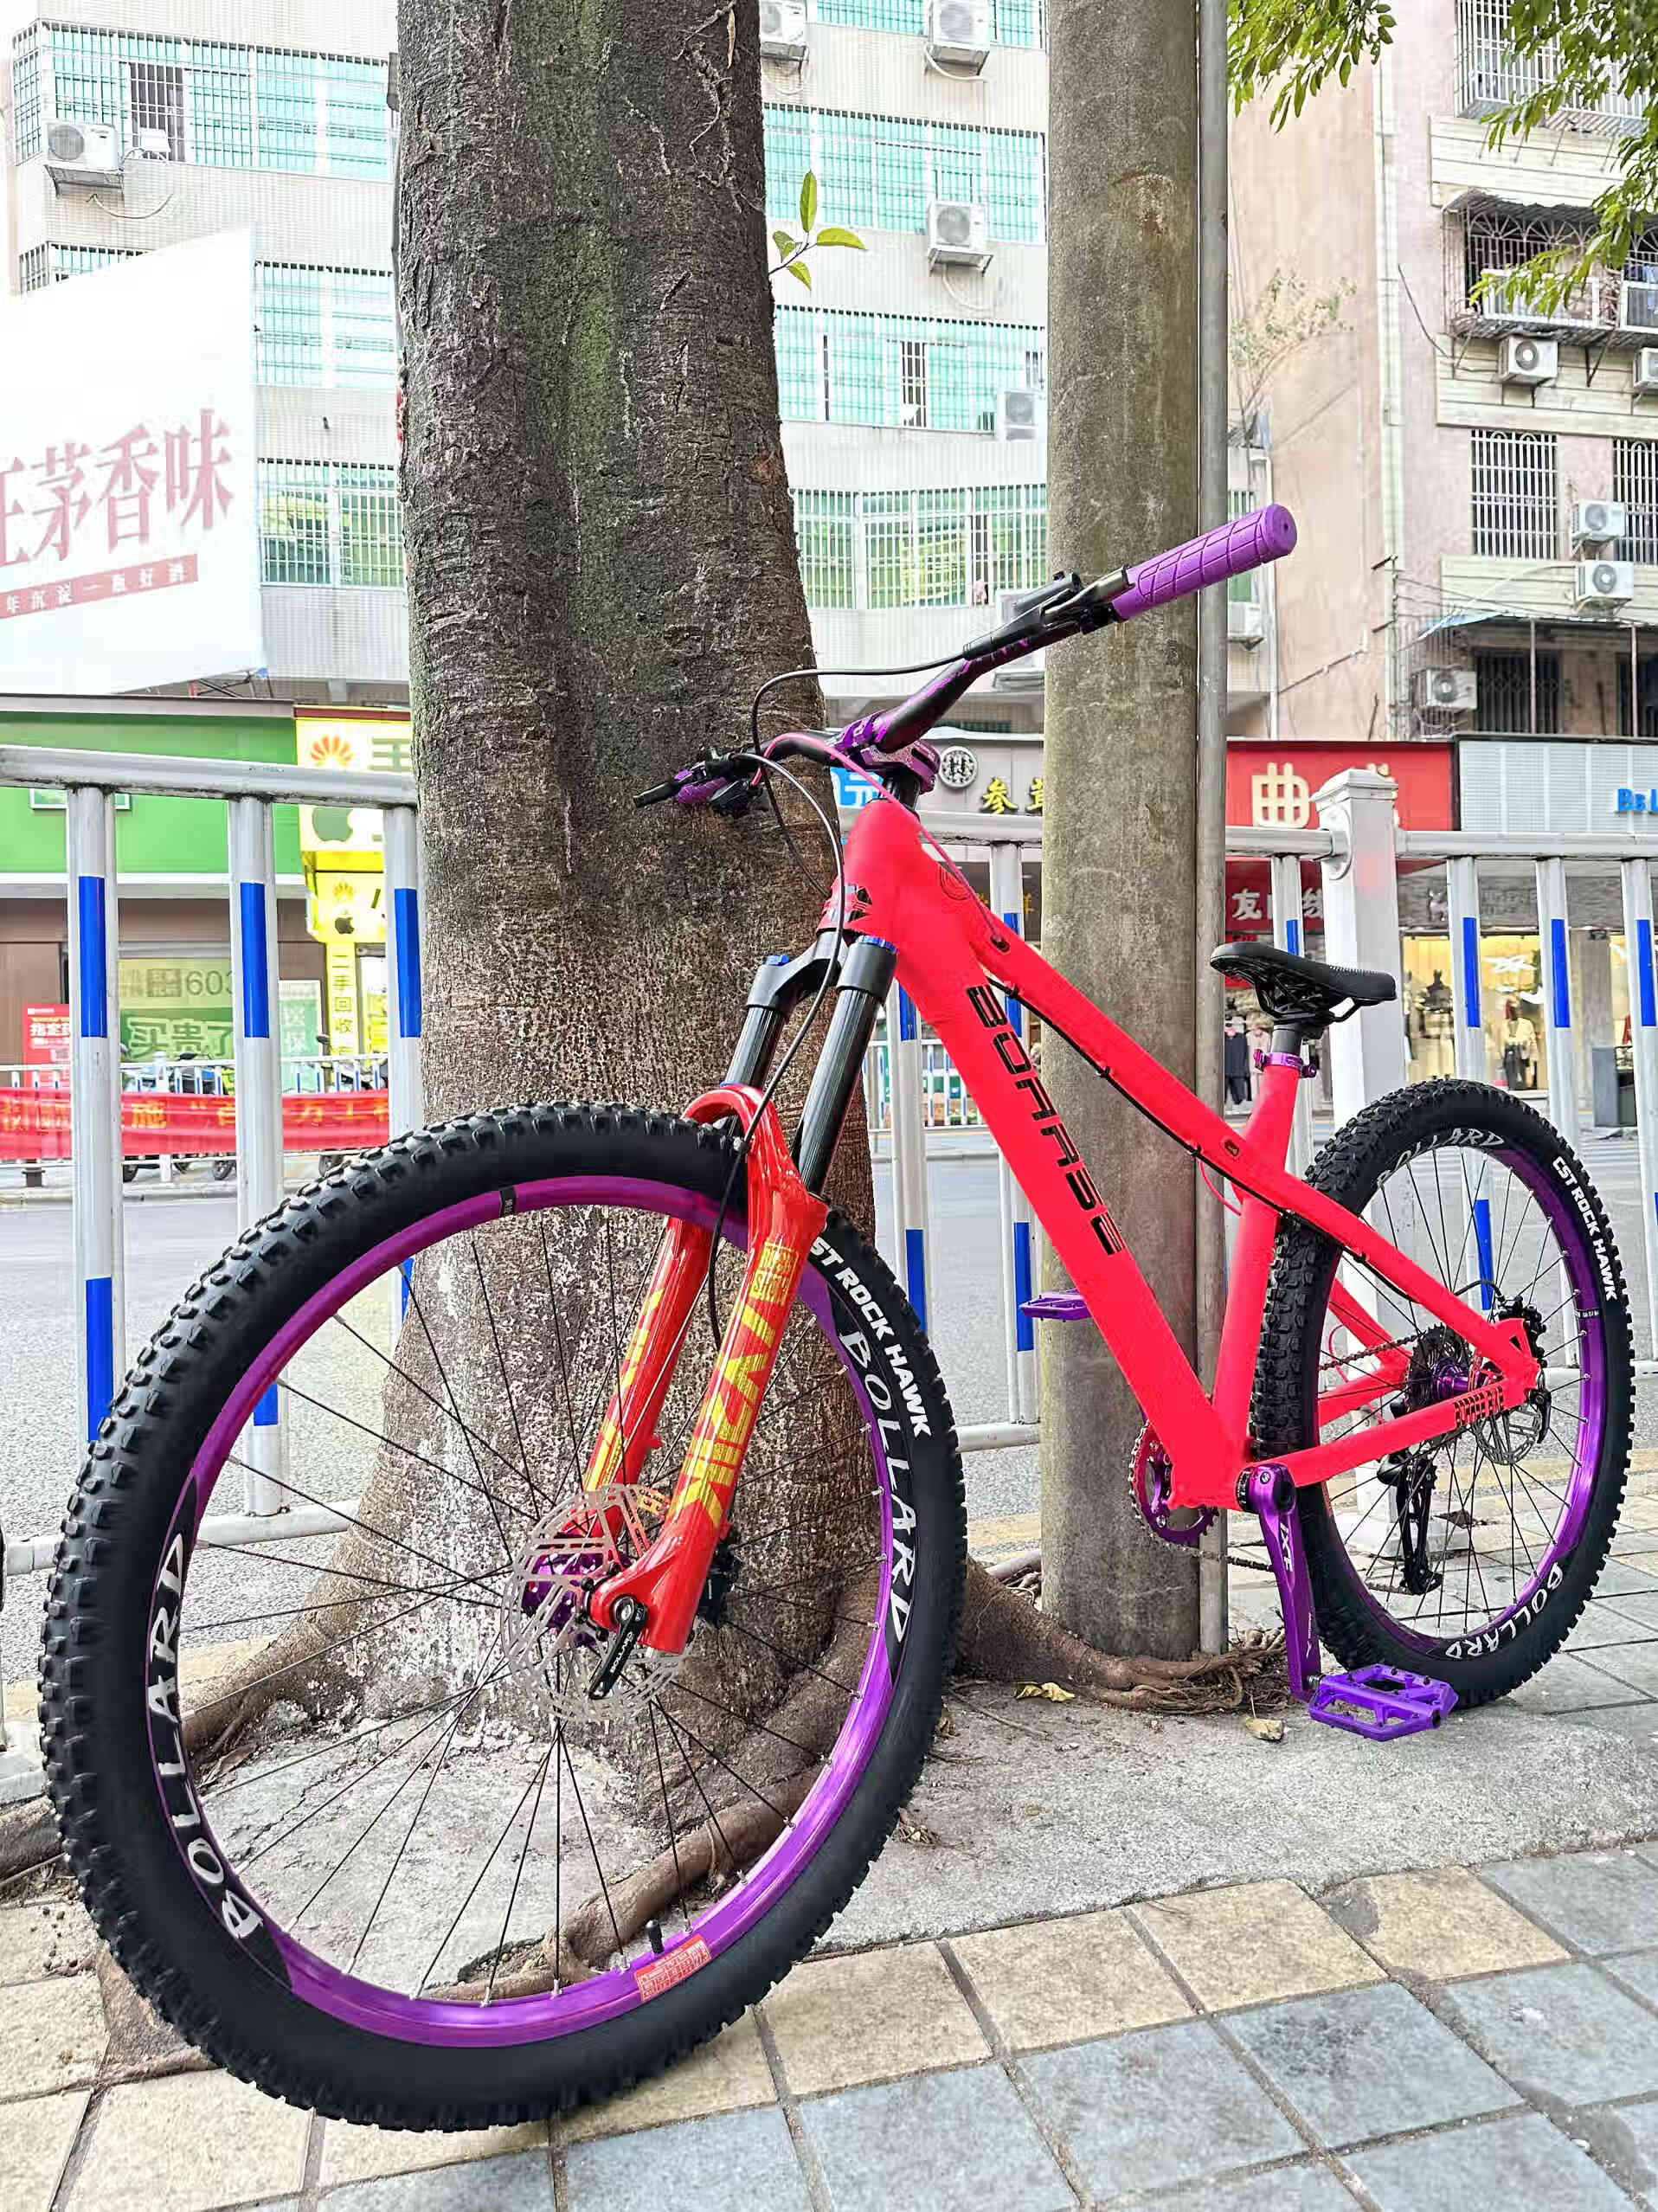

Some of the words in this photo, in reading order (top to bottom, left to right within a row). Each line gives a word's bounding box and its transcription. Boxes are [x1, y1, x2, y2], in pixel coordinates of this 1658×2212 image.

[1552, 1156, 1581, 1194] CST
[1575, 1190, 1601, 1238] ROCK
[1592, 1238, 1618, 1301] HAWK
[810, 1237, 845, 1268] ST
[835, 1266, 895, 1341] ROCK
[884, 1344, 931, 1437] HAWK
[839, 1330, 917, 1643] BOLLARD
[1445, 1561, 1564, 1660] BOLLARD
[147, 1533, 264, 1940] BOLLARD
